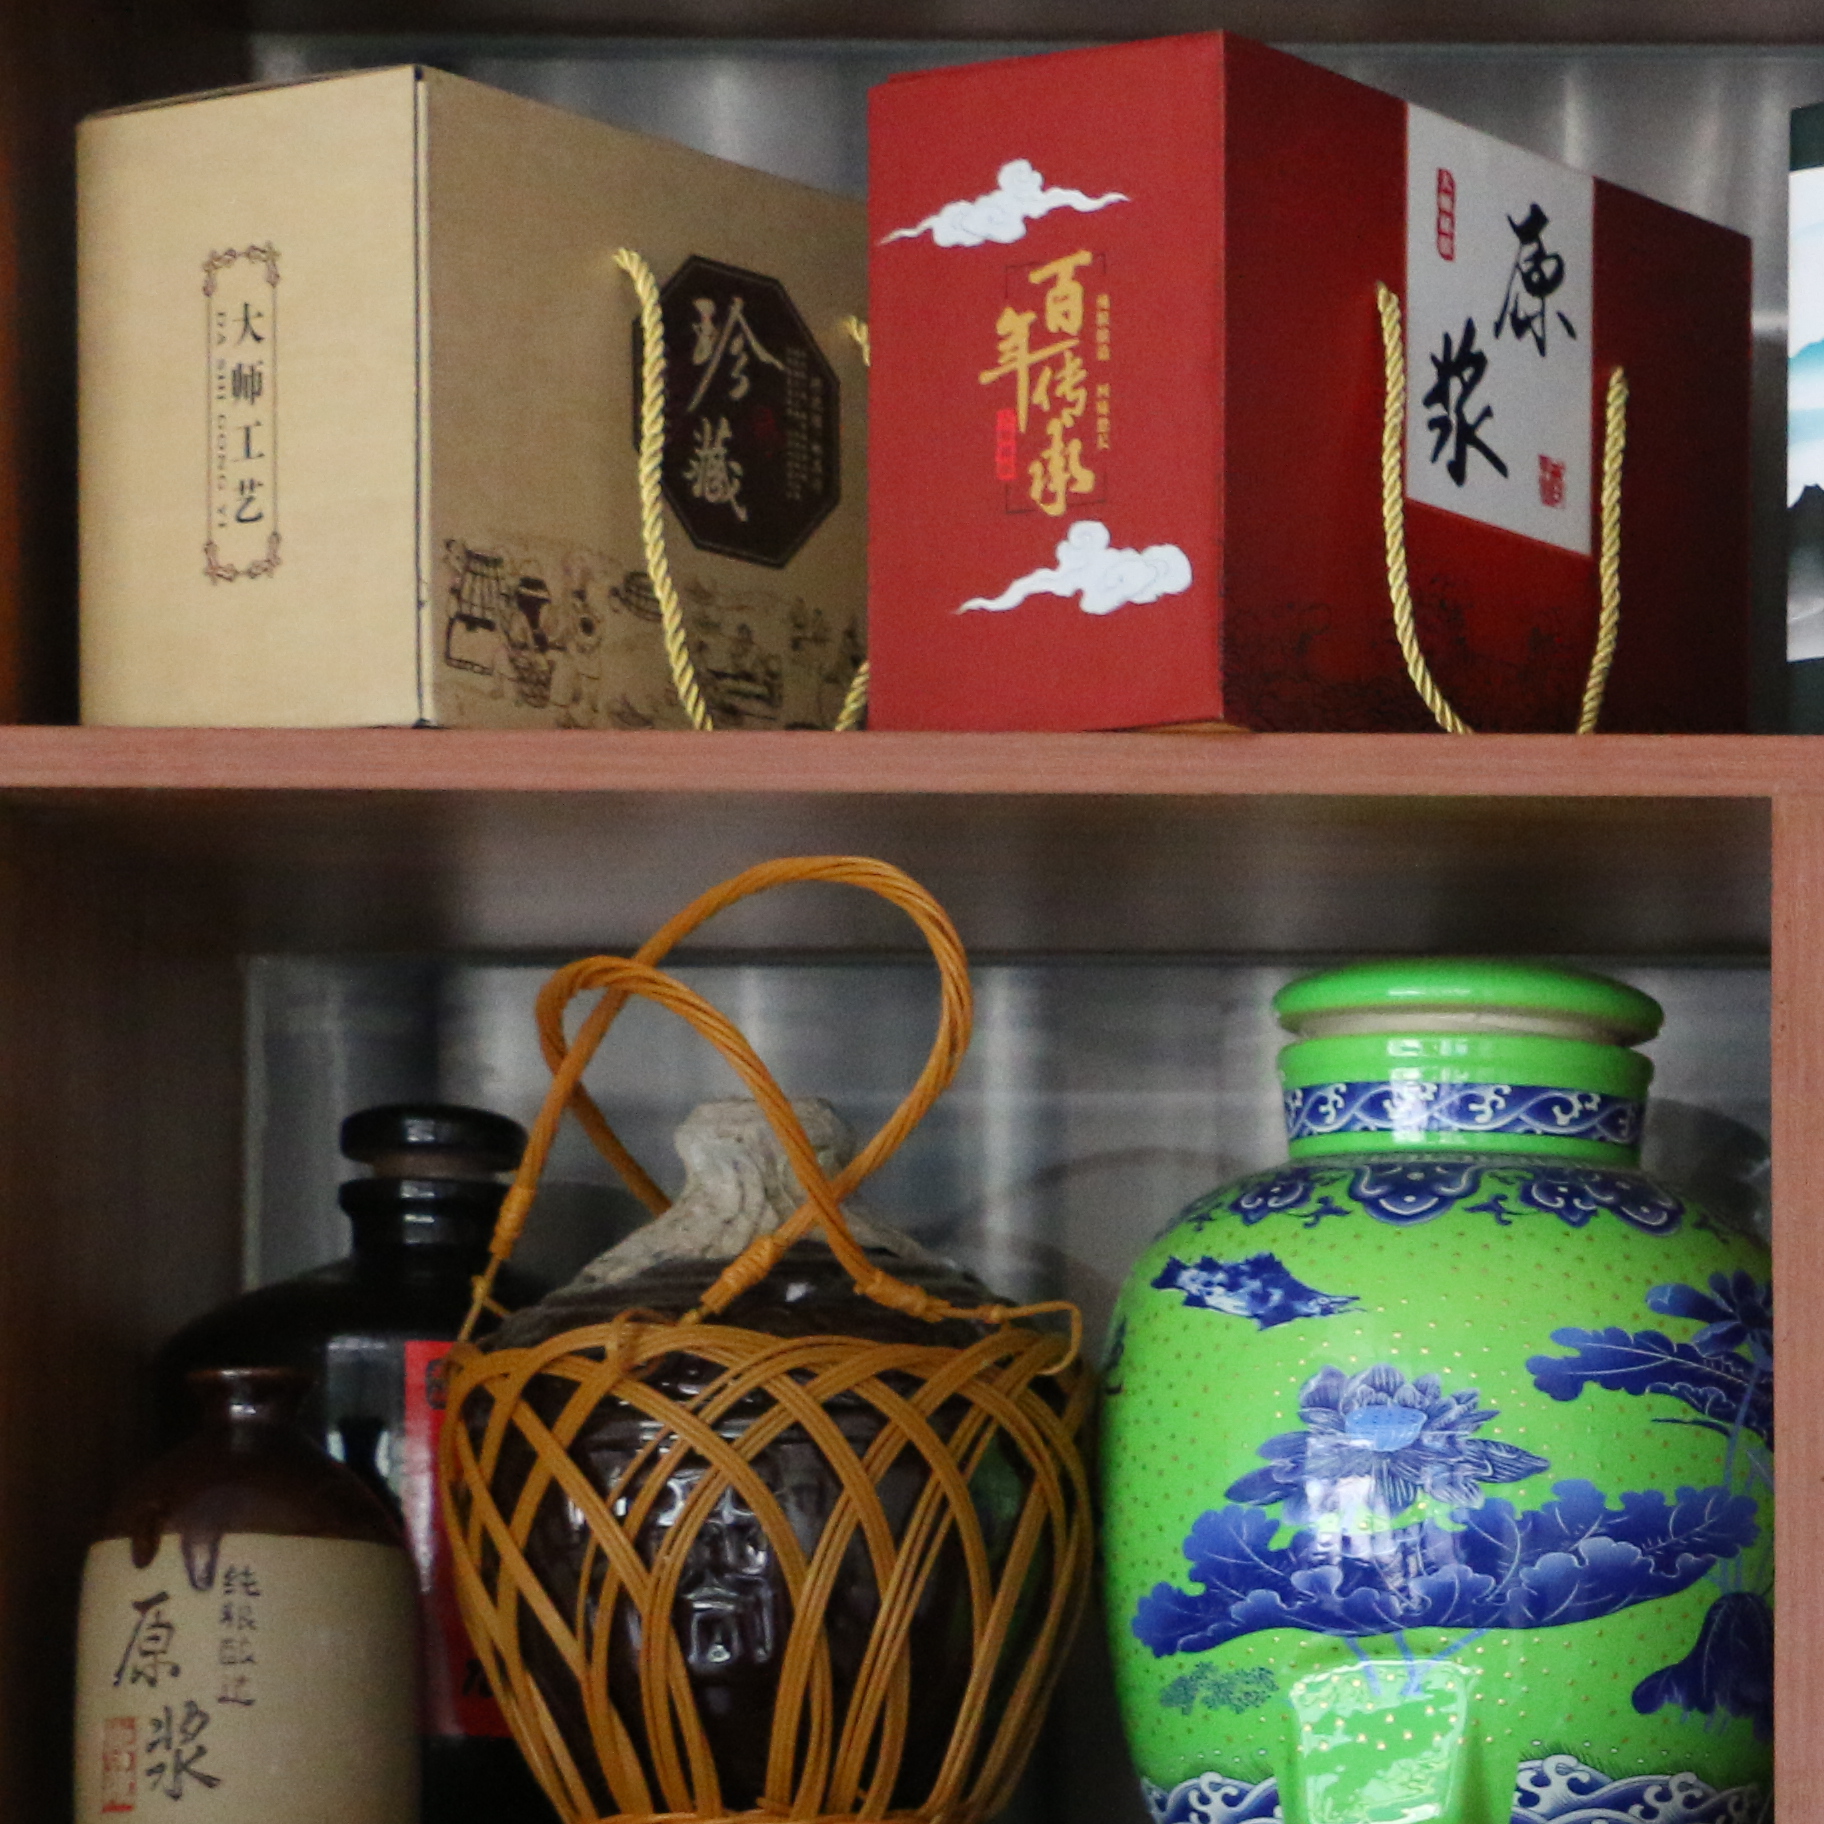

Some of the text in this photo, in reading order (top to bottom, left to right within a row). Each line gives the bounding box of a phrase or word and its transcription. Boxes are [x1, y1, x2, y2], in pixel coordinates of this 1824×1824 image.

[232, 301, 264, 524] 大师工艺
[684, 297, 785, 521] 珍藏
[1423, 203, 1577, 486] 原浆
[113, 1591, 222, 1801] 原浆
